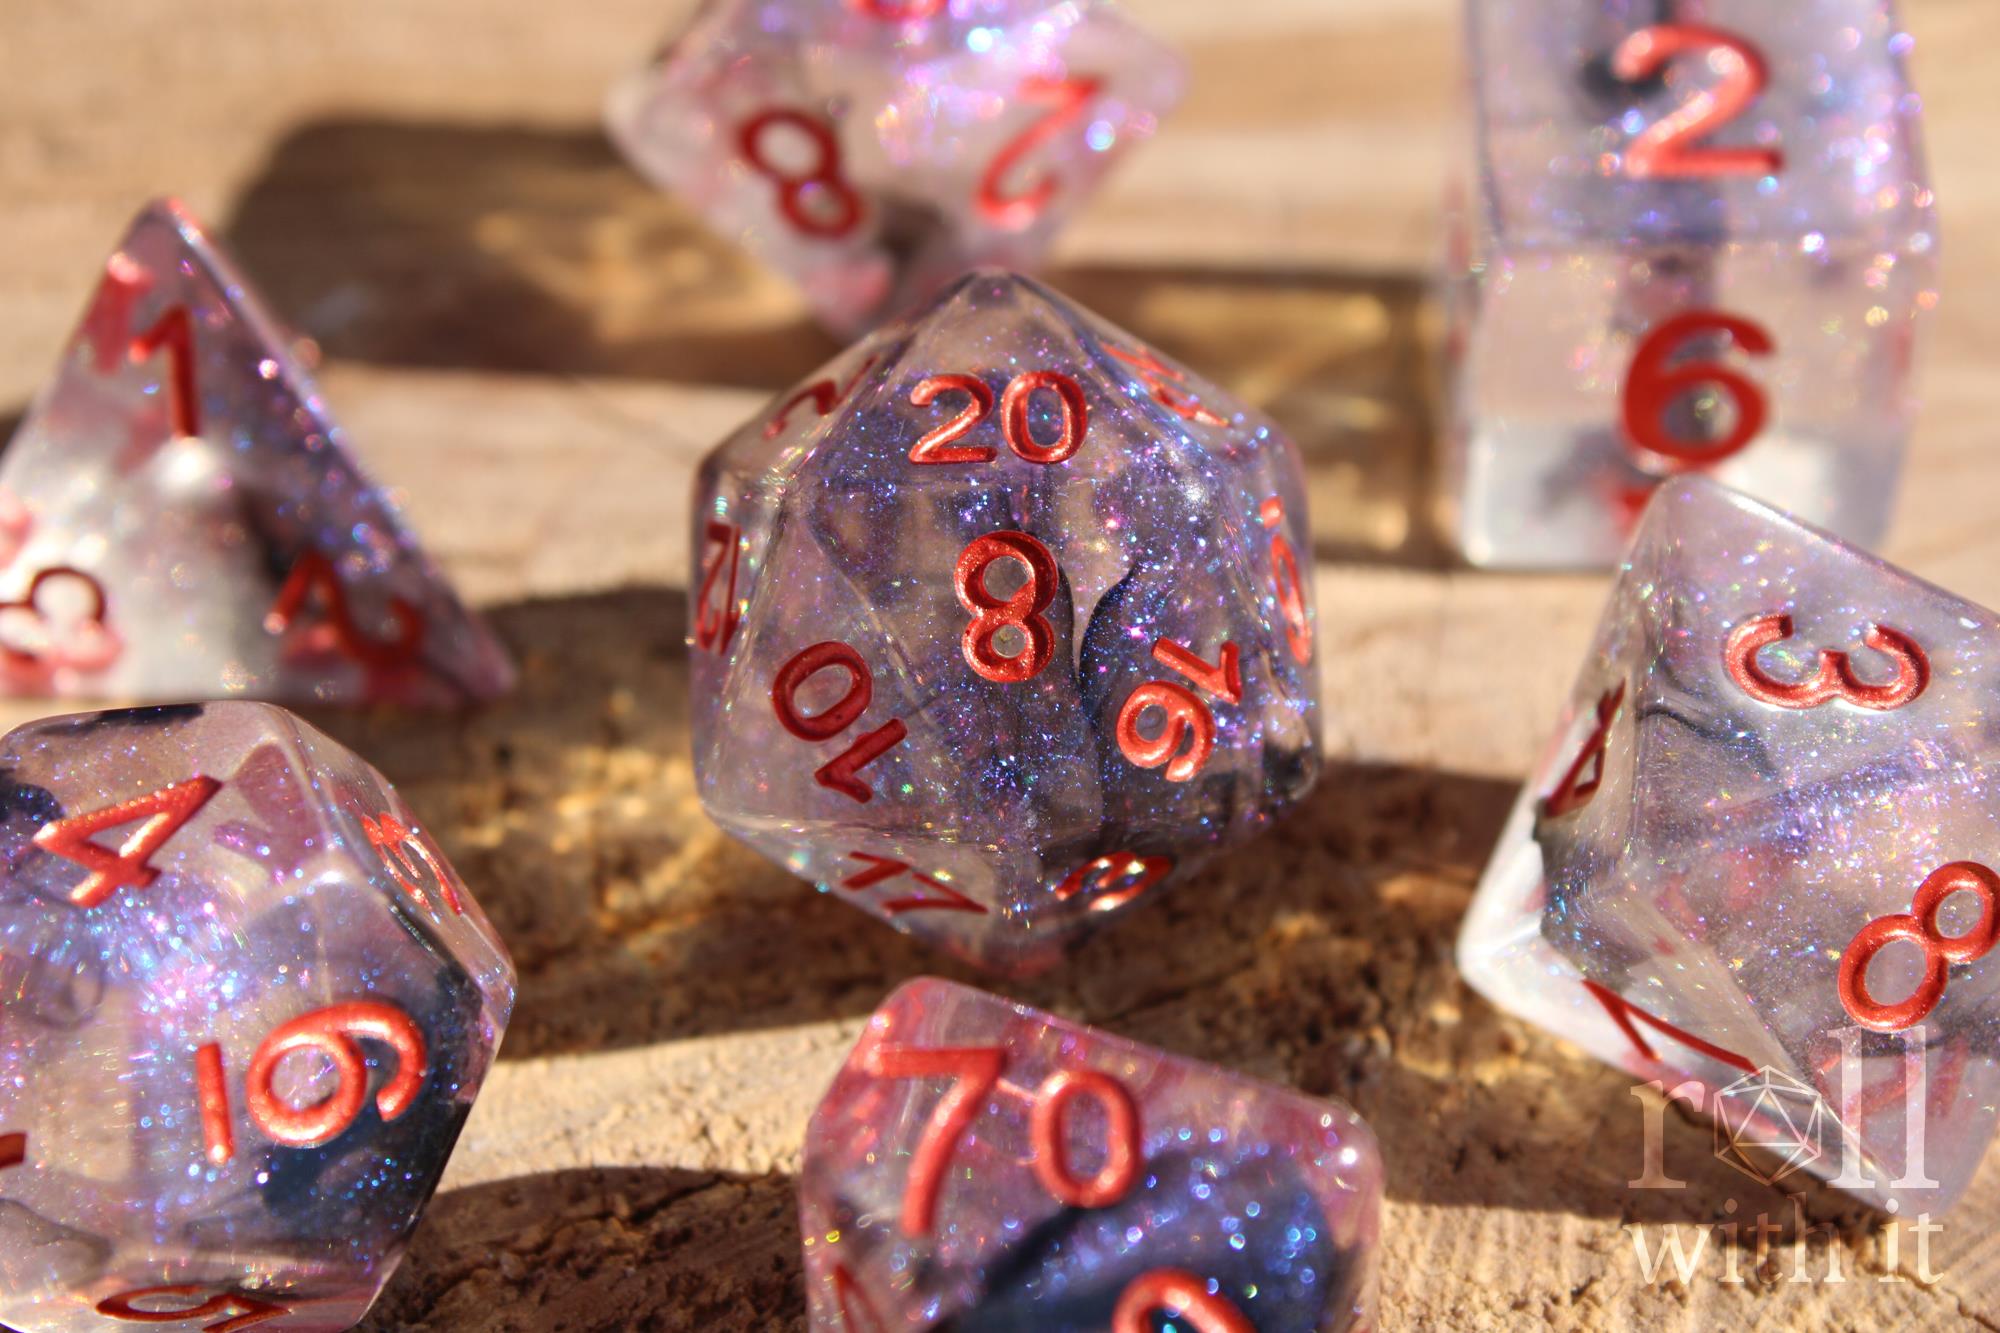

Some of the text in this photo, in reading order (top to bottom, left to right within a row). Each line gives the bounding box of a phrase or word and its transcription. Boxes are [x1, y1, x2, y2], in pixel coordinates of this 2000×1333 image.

[737, 108, 867, 241] 8
[1612, 24, 1786, 180] 2
[128, 302, 200, 438] 1
[908, 370, 1088, 465] 20
[1622, 308, 1776, 474] 6
[953, 530, 1060, 684] 8
[1725, 612, 1932, 712] 3
[772, 640, 908, 804] 10
[1116, 636, 1244, 784] 16
[32, 774, 224, 909] 4
[1838, 860, 2000, 1032] 8
[864, 1044, 1145, 1239] 70
